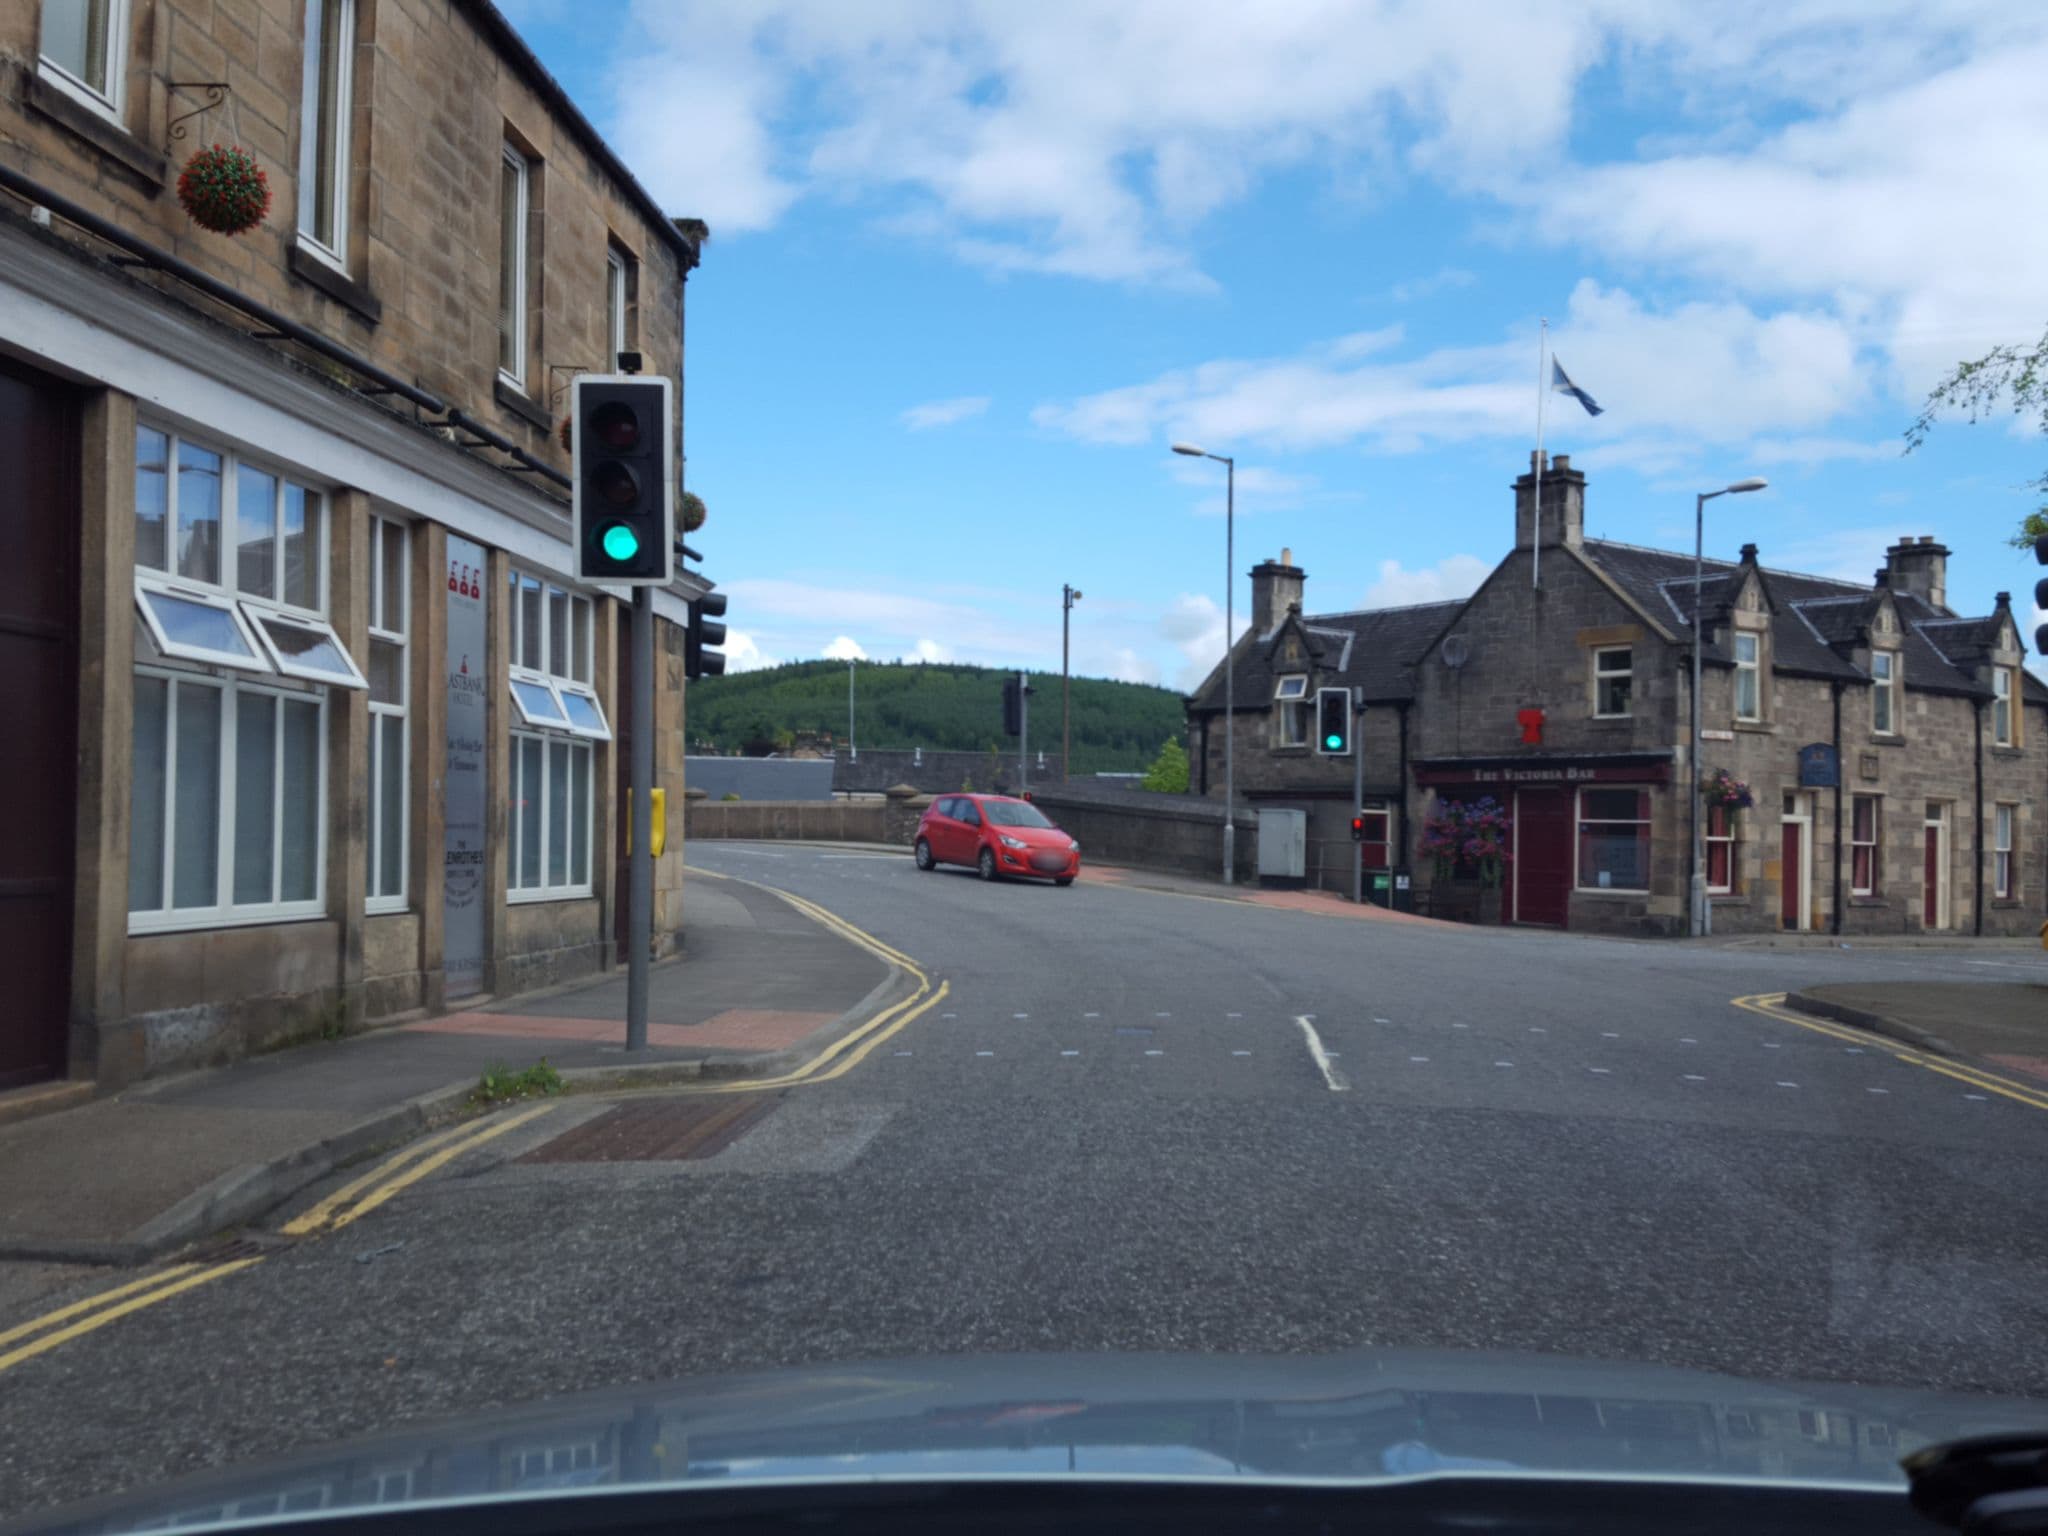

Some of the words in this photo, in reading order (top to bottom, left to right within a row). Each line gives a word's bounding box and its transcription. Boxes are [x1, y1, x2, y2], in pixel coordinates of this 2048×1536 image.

[446, 672, 485, 696] ASTBANK
[1474, 768, 1498, 780] THE
[1503, 768, 1562, 780] VICTORIA
[1567, 767, 1595, 779] BAR
